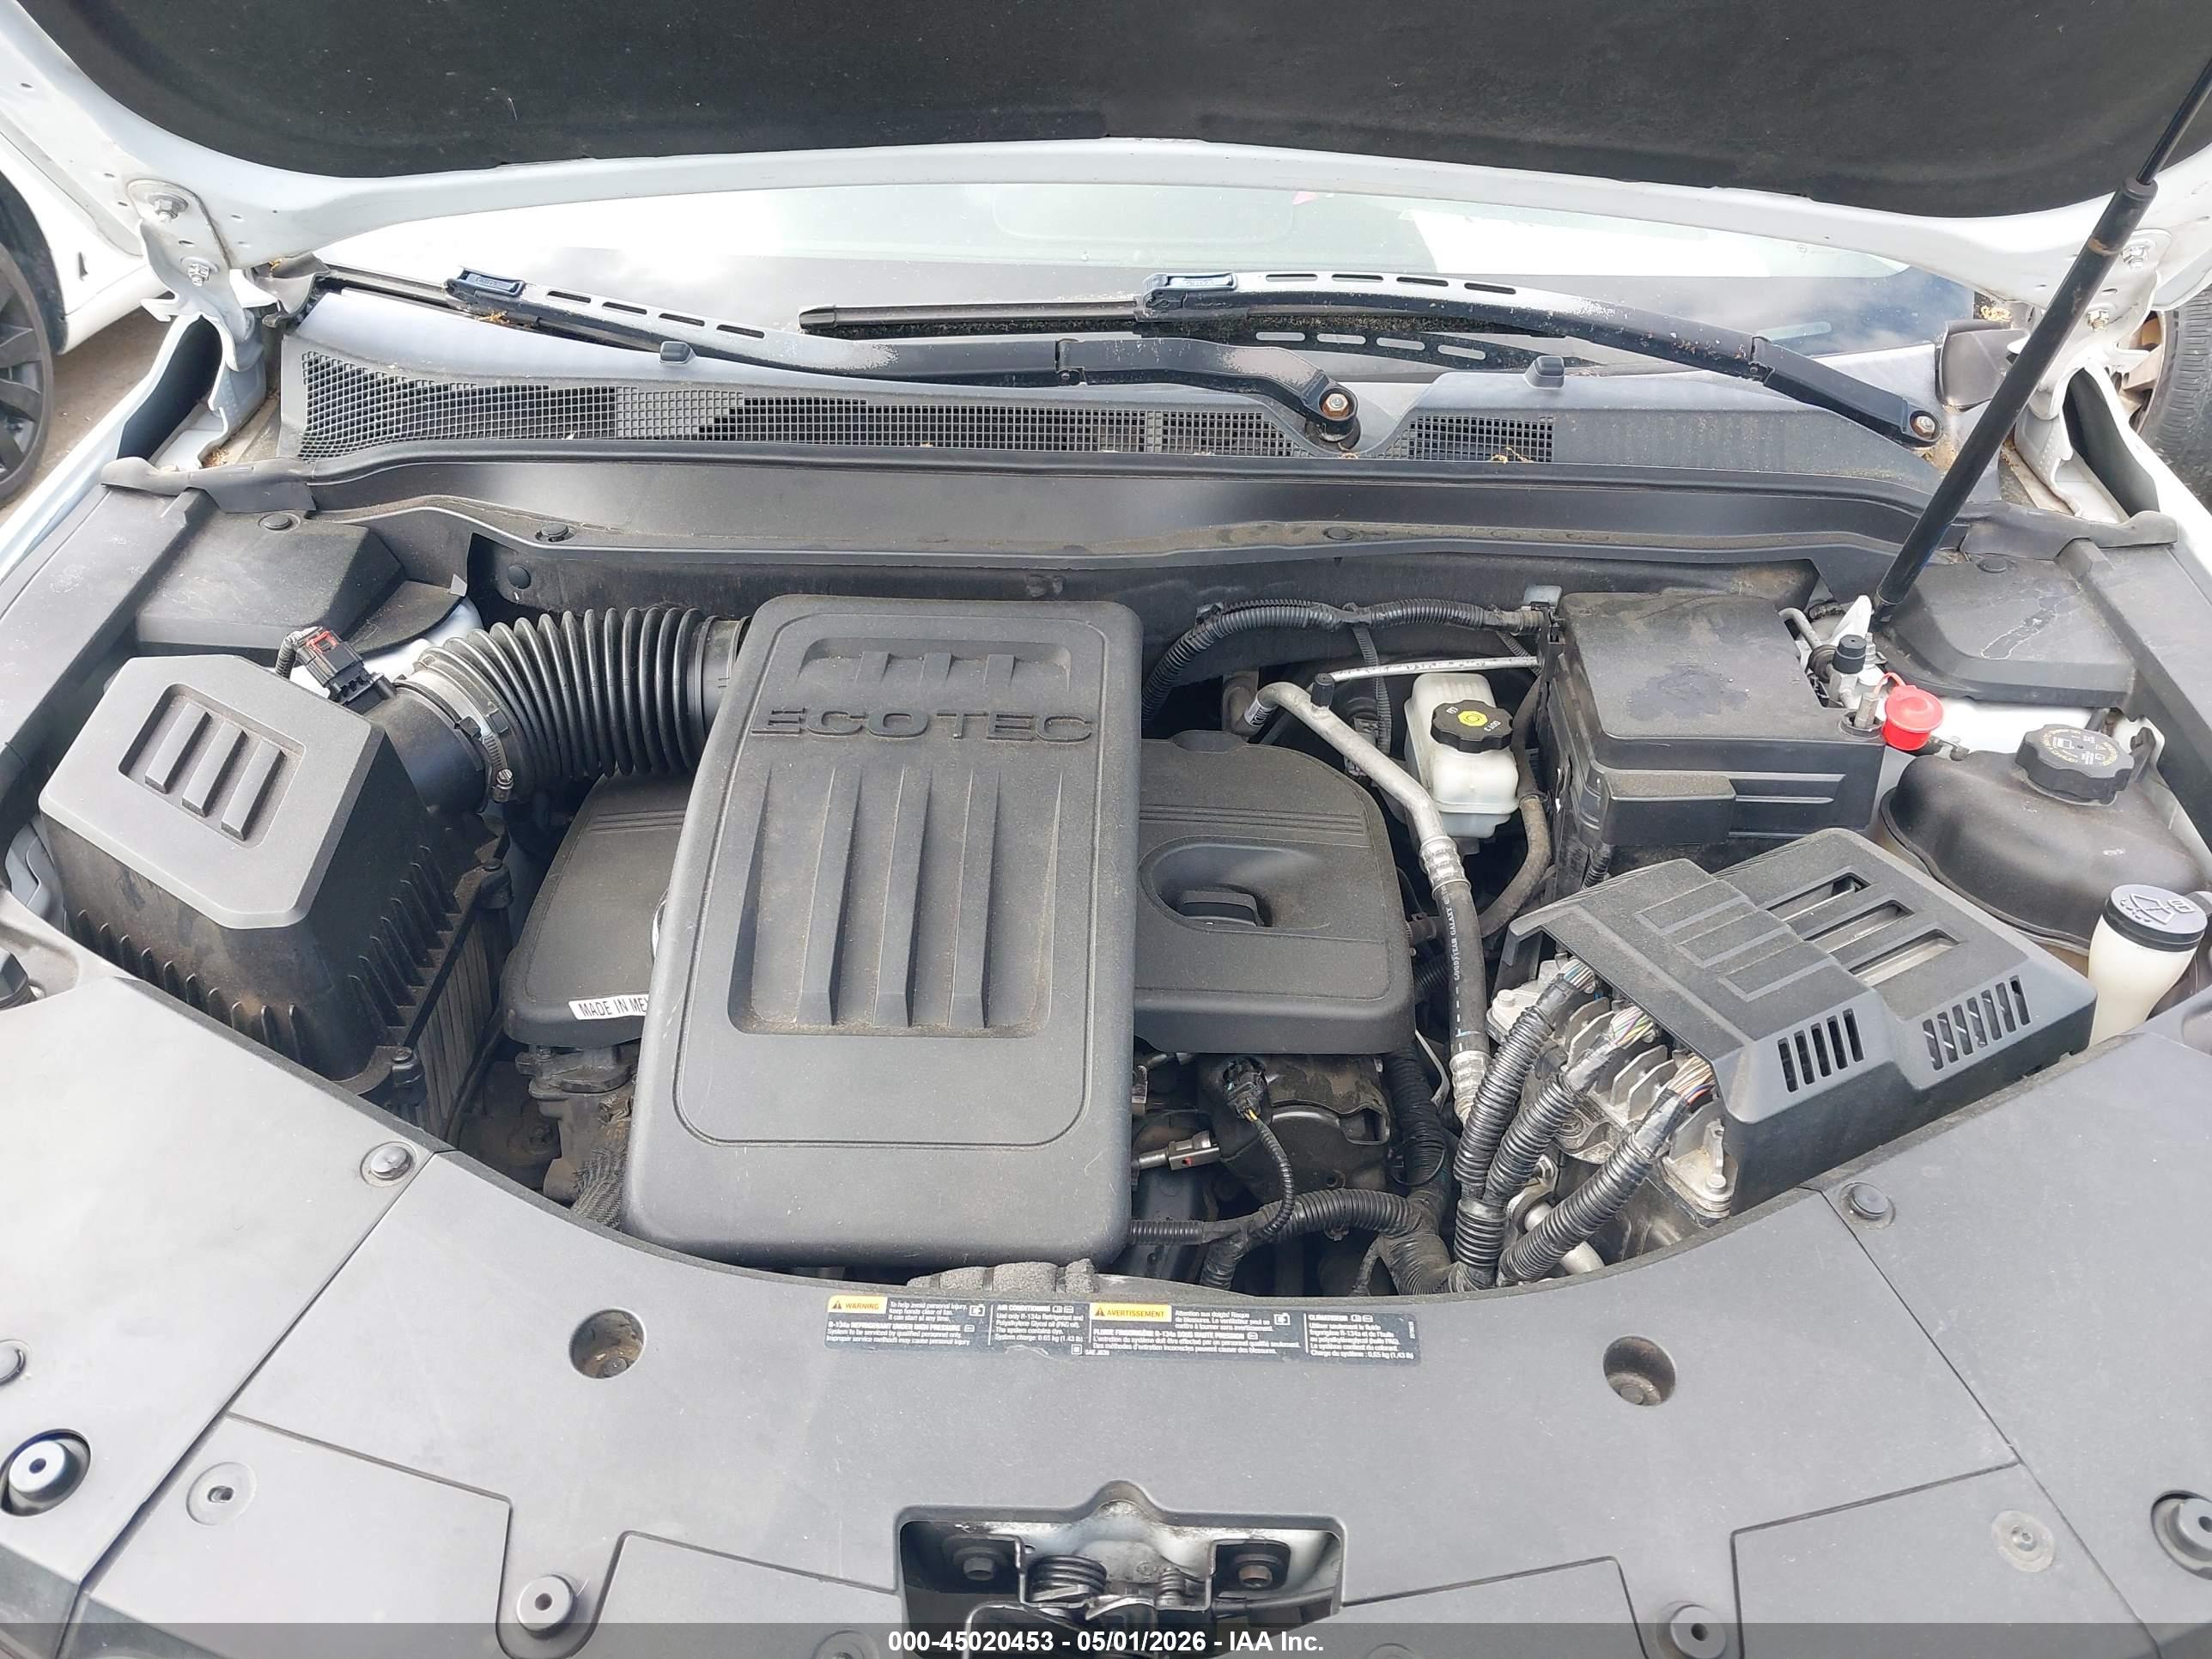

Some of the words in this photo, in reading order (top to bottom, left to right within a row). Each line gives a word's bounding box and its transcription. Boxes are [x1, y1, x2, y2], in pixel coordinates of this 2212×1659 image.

[750, 706, 1091, 743] ECOTEC
[1446, 907, 1456, 936] GALAXY
[579, 1000, 611, 1017] MADE
[613, 998, 629, 1013] IN
